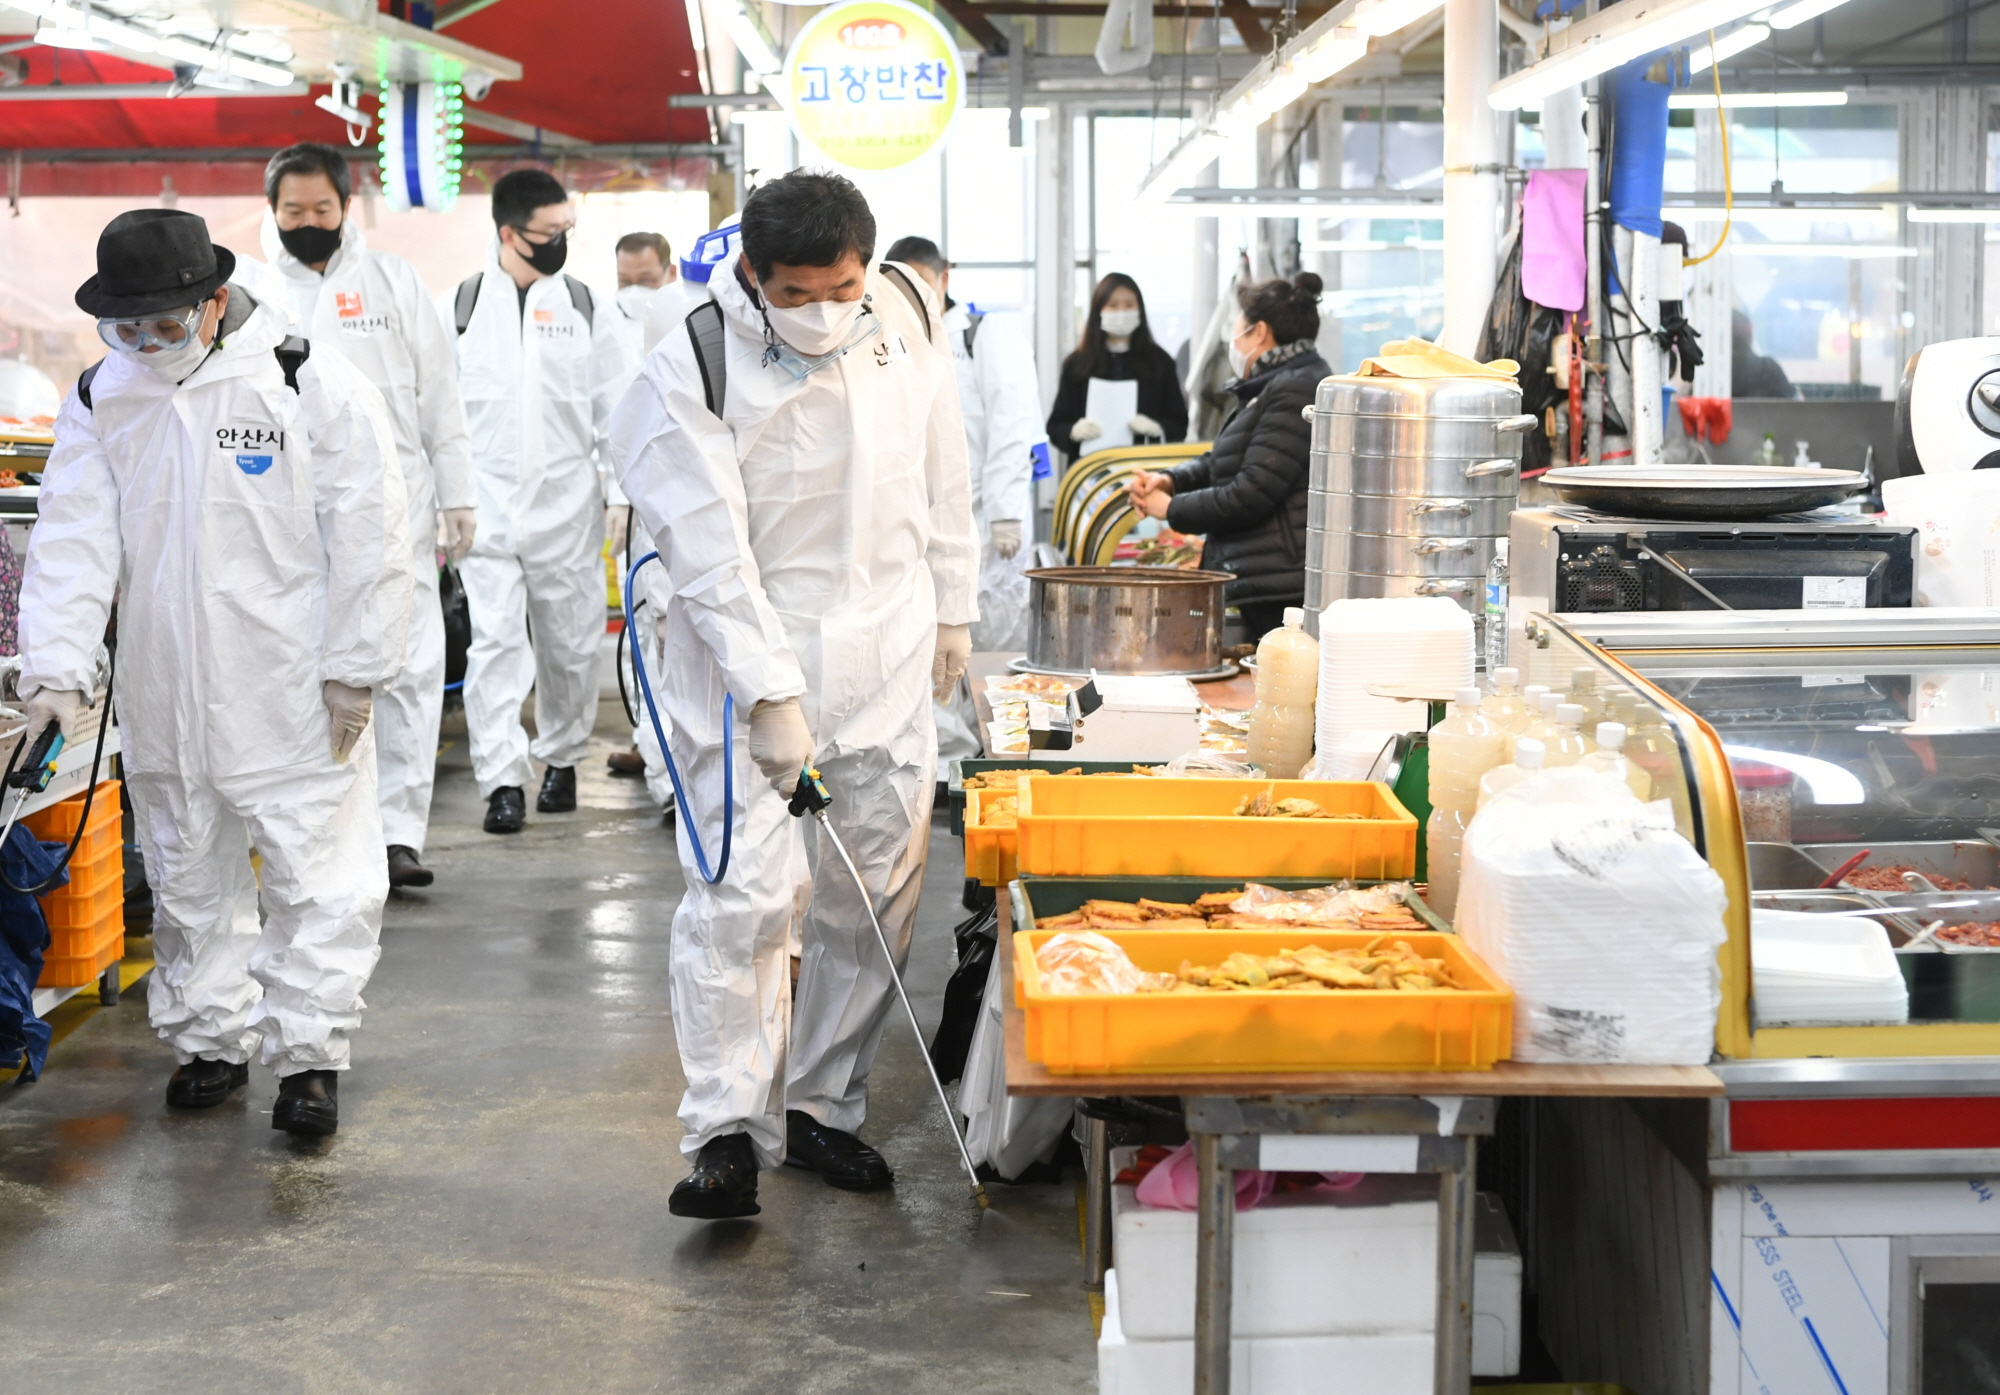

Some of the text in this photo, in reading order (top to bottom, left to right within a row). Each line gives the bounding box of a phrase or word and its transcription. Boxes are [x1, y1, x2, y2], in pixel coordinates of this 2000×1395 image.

[801, 61, 947, 103] 고창반찬
[216, 428, 284, 451] 안산시
[1760, 1201, 1777, 1222] the
[1772, 1269, 1805, 1318] STEEL
